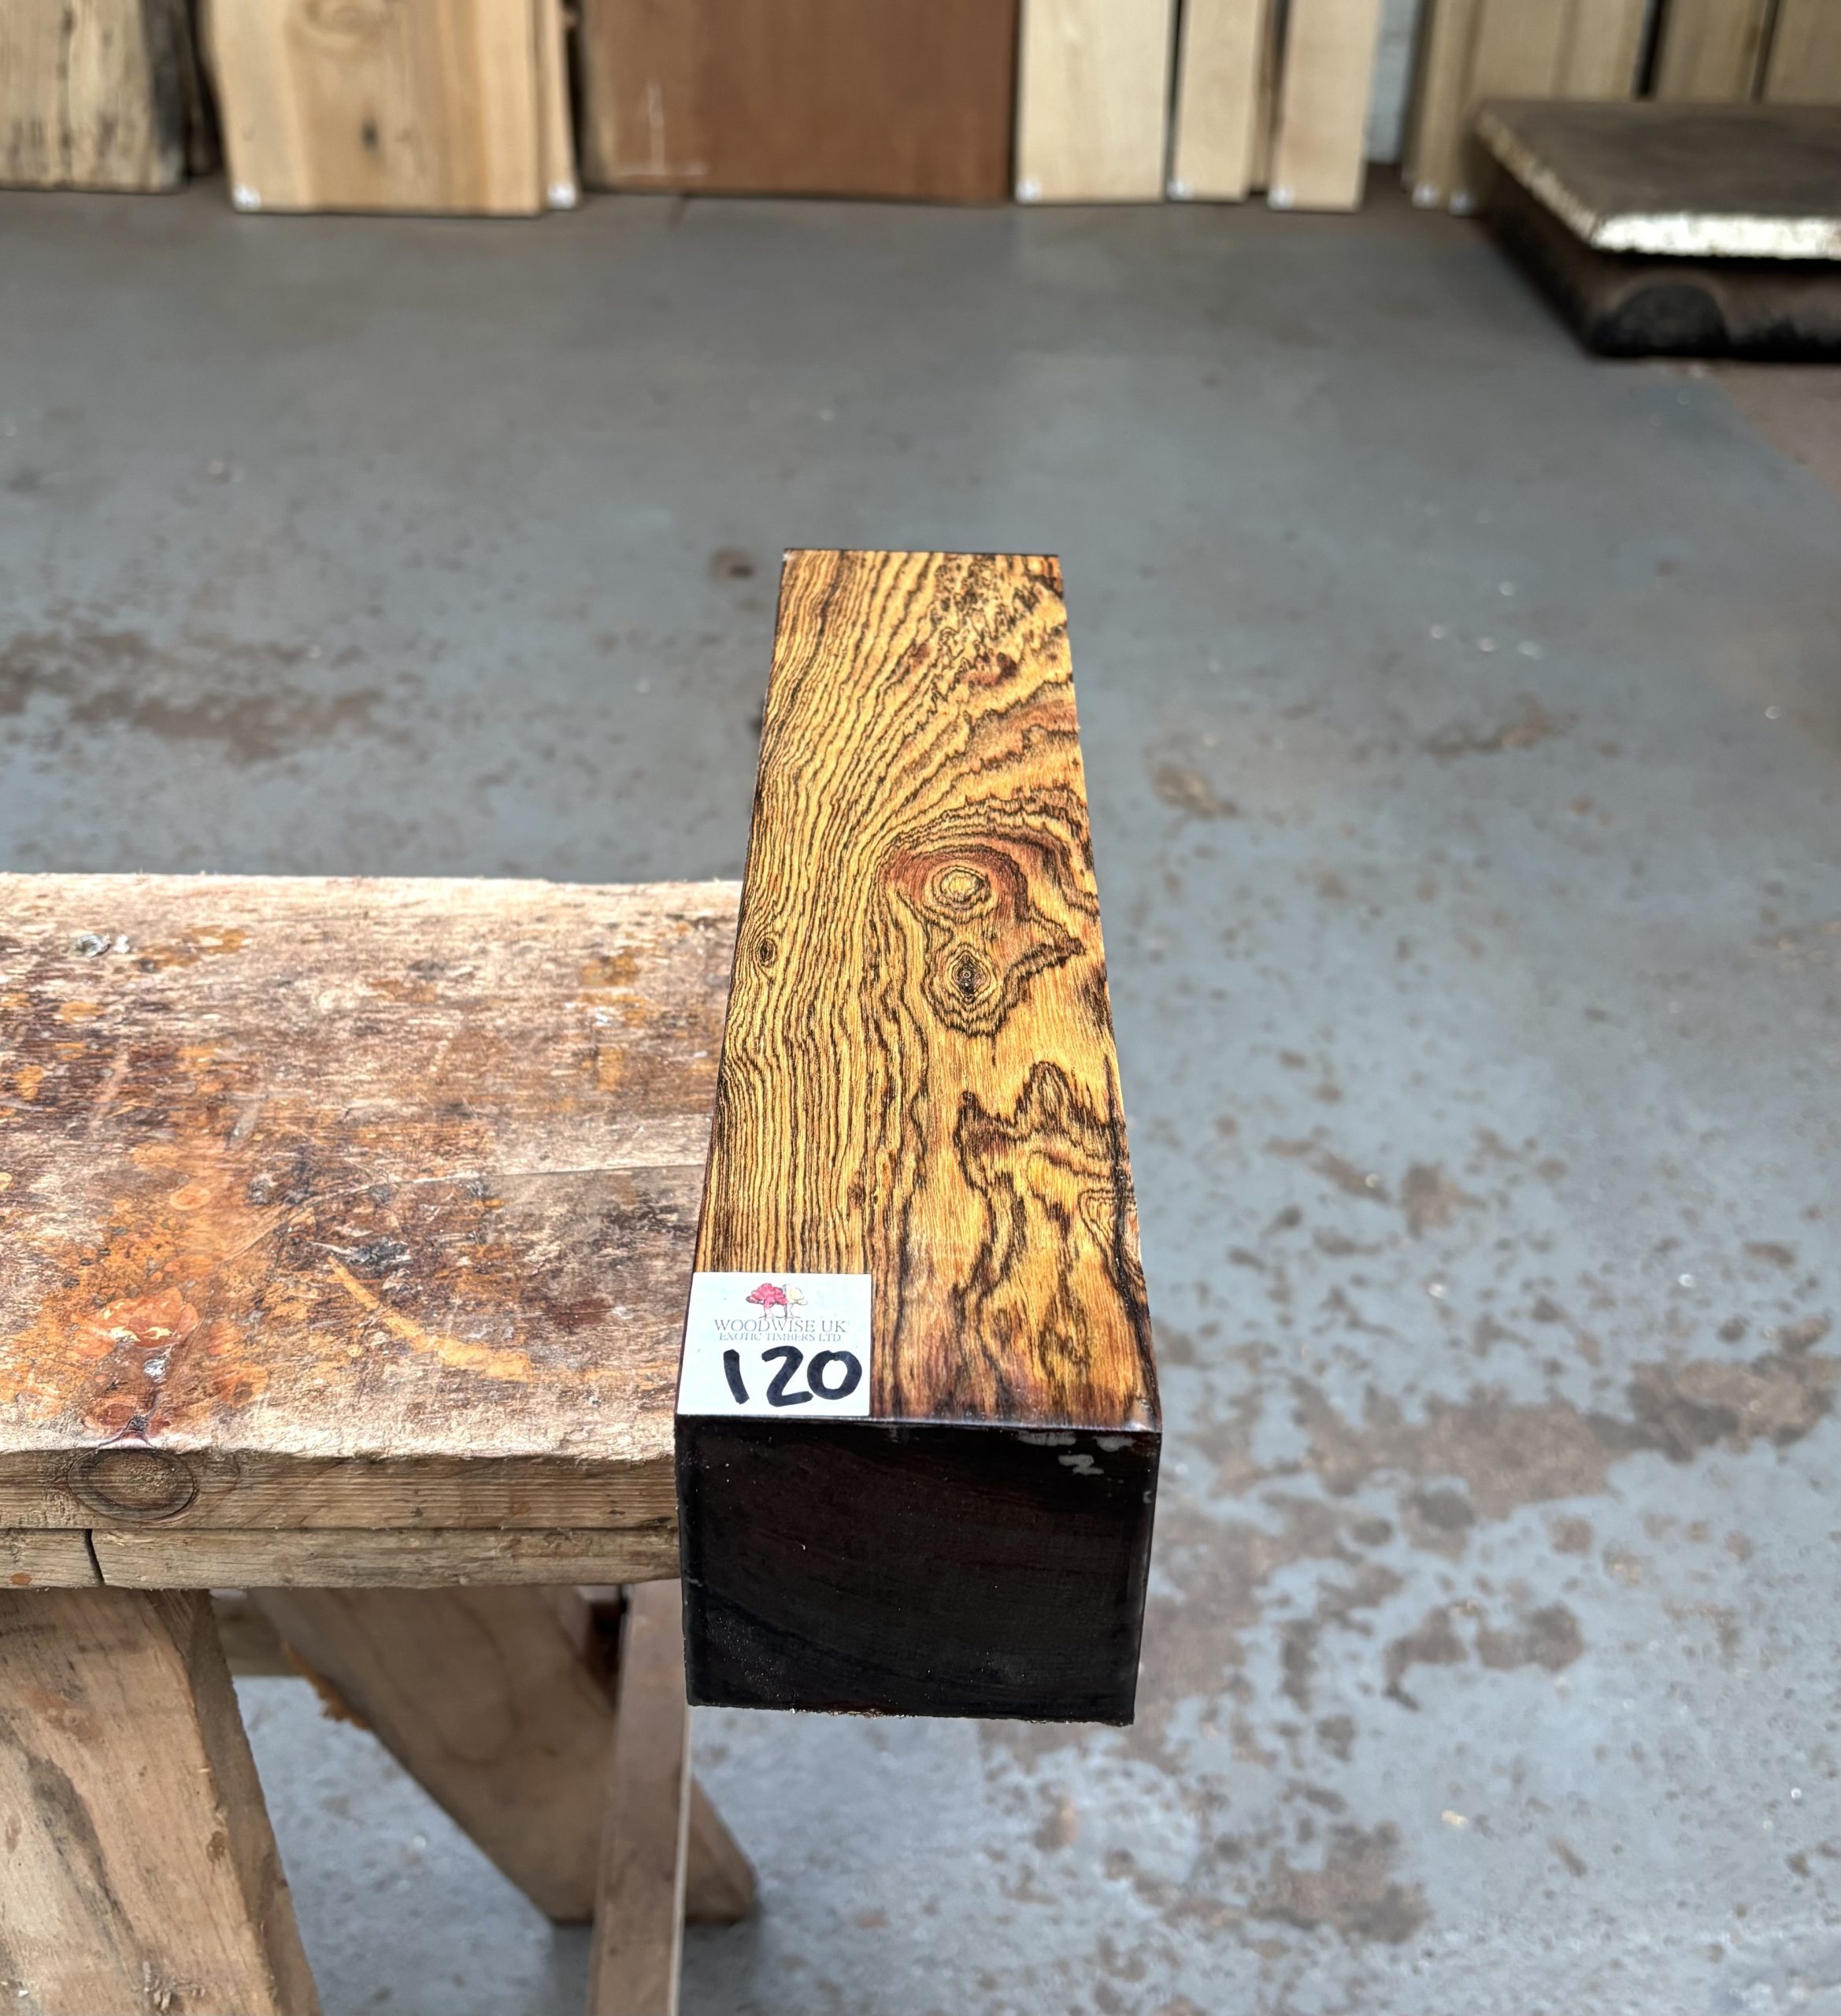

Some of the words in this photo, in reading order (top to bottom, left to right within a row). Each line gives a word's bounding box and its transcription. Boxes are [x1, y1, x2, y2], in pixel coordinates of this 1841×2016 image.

[714, 1319, 815, 1332] WOODWISE
[821, 1320, 847, 1332] UK
[719, 1332, 761, 1341] EXOTIC
[765, 1332, 815, 1342] TIMBERS
[819, 1333, 842, 1342] LTD
[723, 1345, 863, 1407] 120
